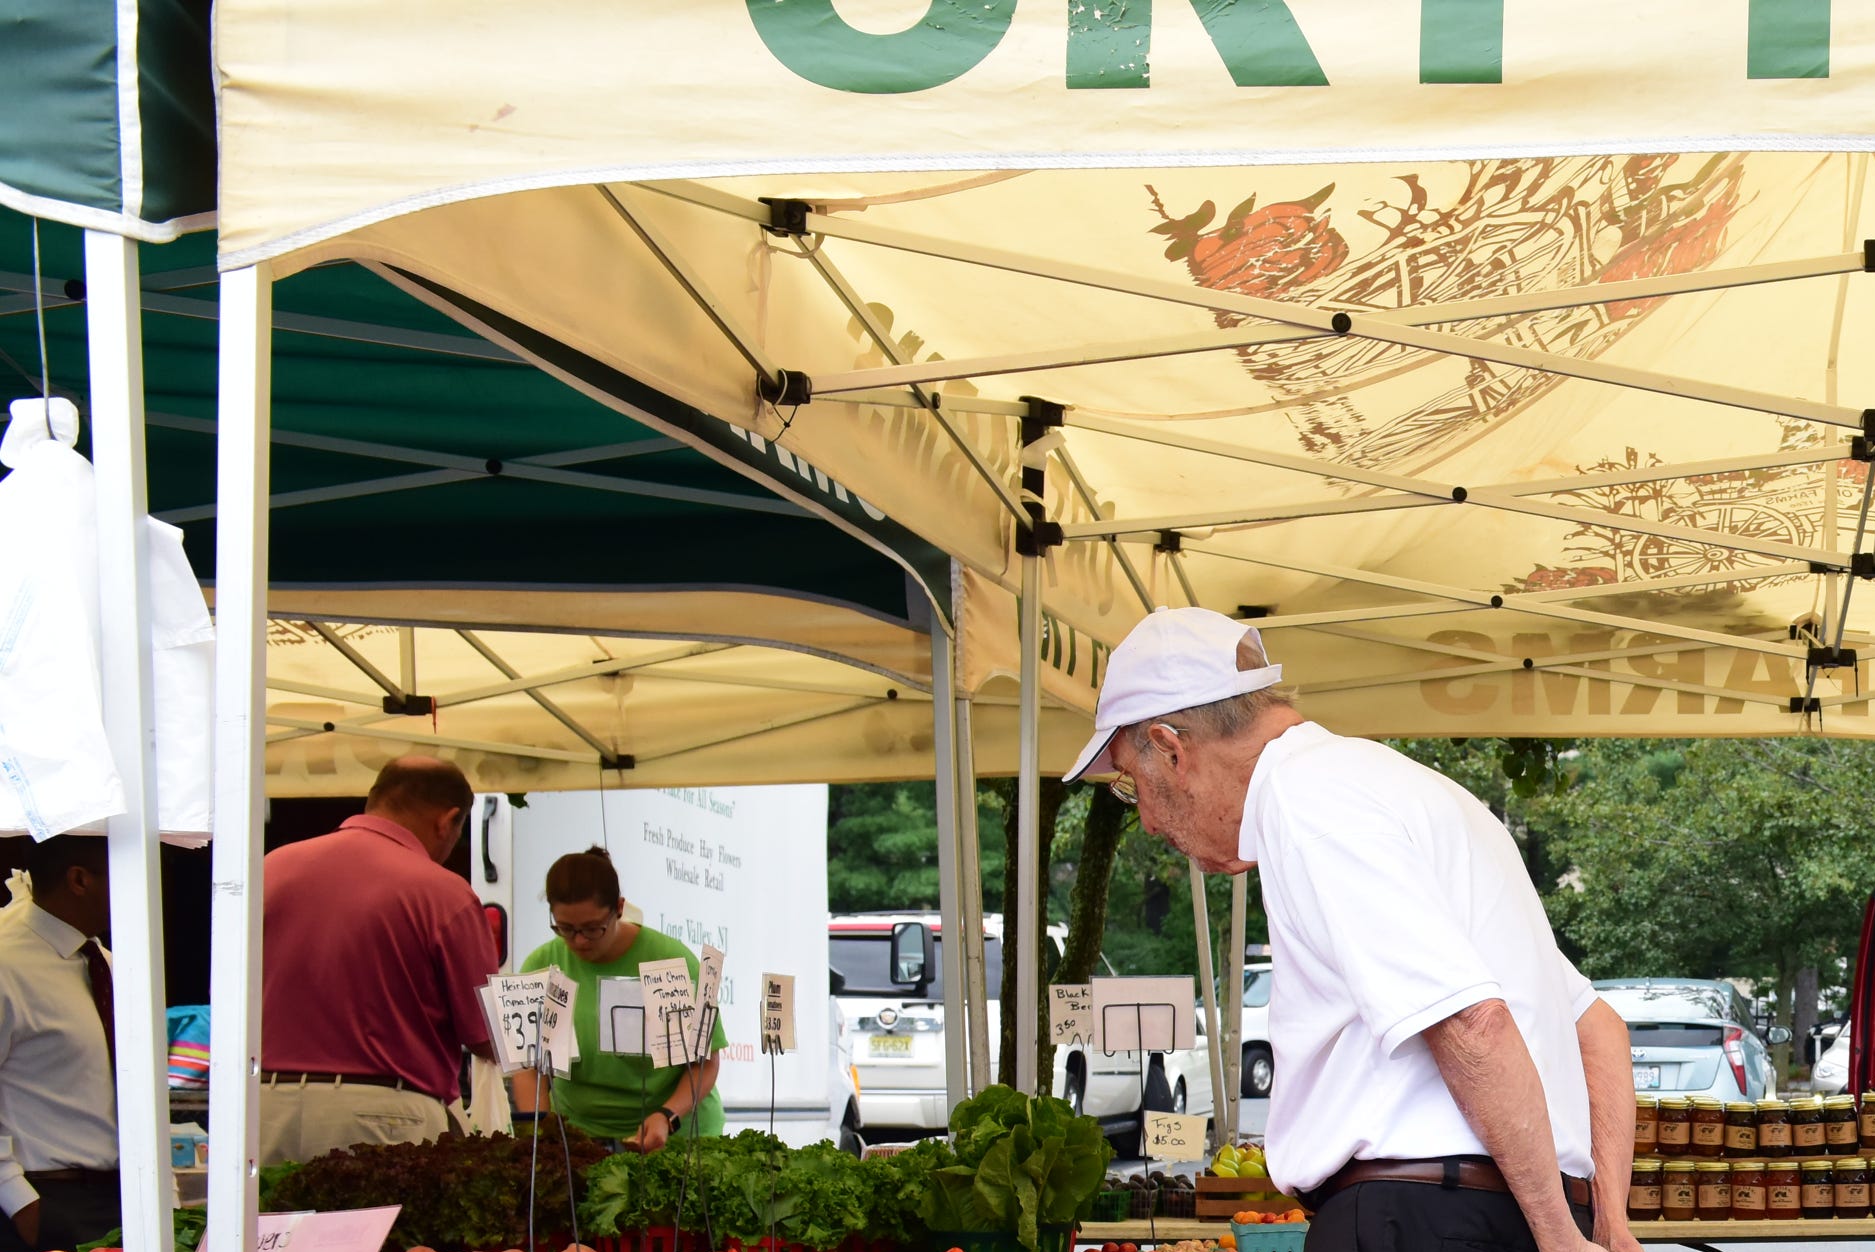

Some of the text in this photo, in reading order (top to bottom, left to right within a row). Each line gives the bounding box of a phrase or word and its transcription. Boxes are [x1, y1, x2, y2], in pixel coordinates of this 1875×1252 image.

[643, 822, 741, 869] Fresh Produce Hay Flowers
[666, 857, 724, 891] Wholesale Retail
[660, 913, 683, 941] Long
[718, 926, 728, 957] NJ
[502, 980, 544, 993] Heirloom
